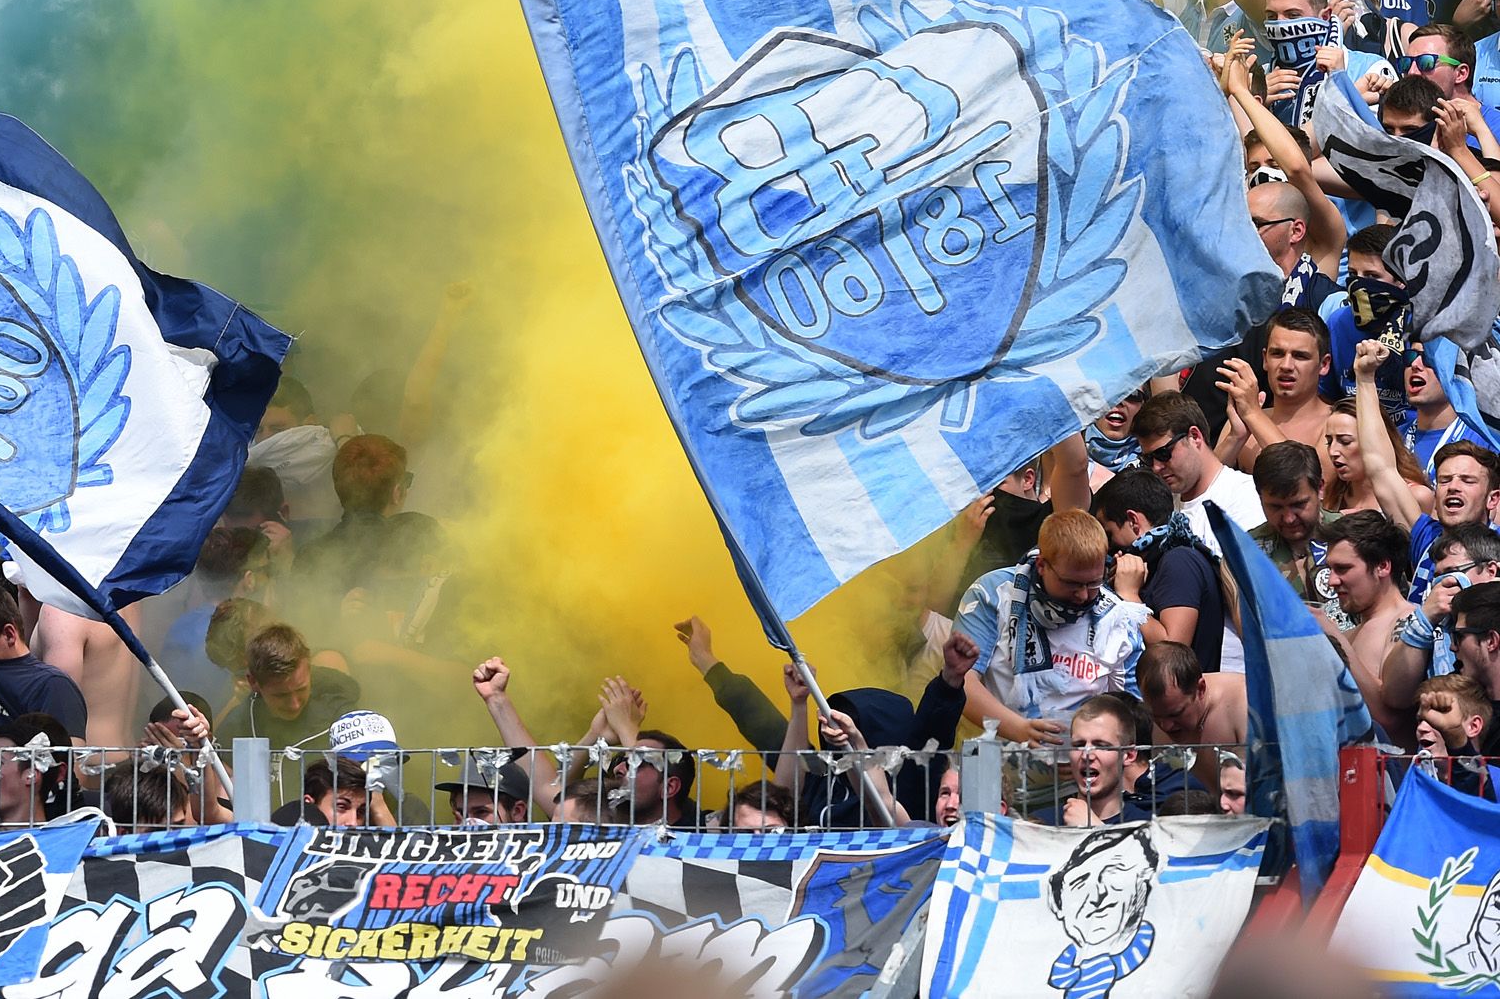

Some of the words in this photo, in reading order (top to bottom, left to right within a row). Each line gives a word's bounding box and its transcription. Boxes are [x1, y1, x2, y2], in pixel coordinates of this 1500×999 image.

[1379, 336, 1402, 350] 860
[303, 827, 546, 865] EINIGKEIT
[560, 840, 621, 860] UND
[368, 873, 521, 910] RECHT
[556, 883, 613, 910] UND
[278, 921, 544, 962] SICHERHEIT
